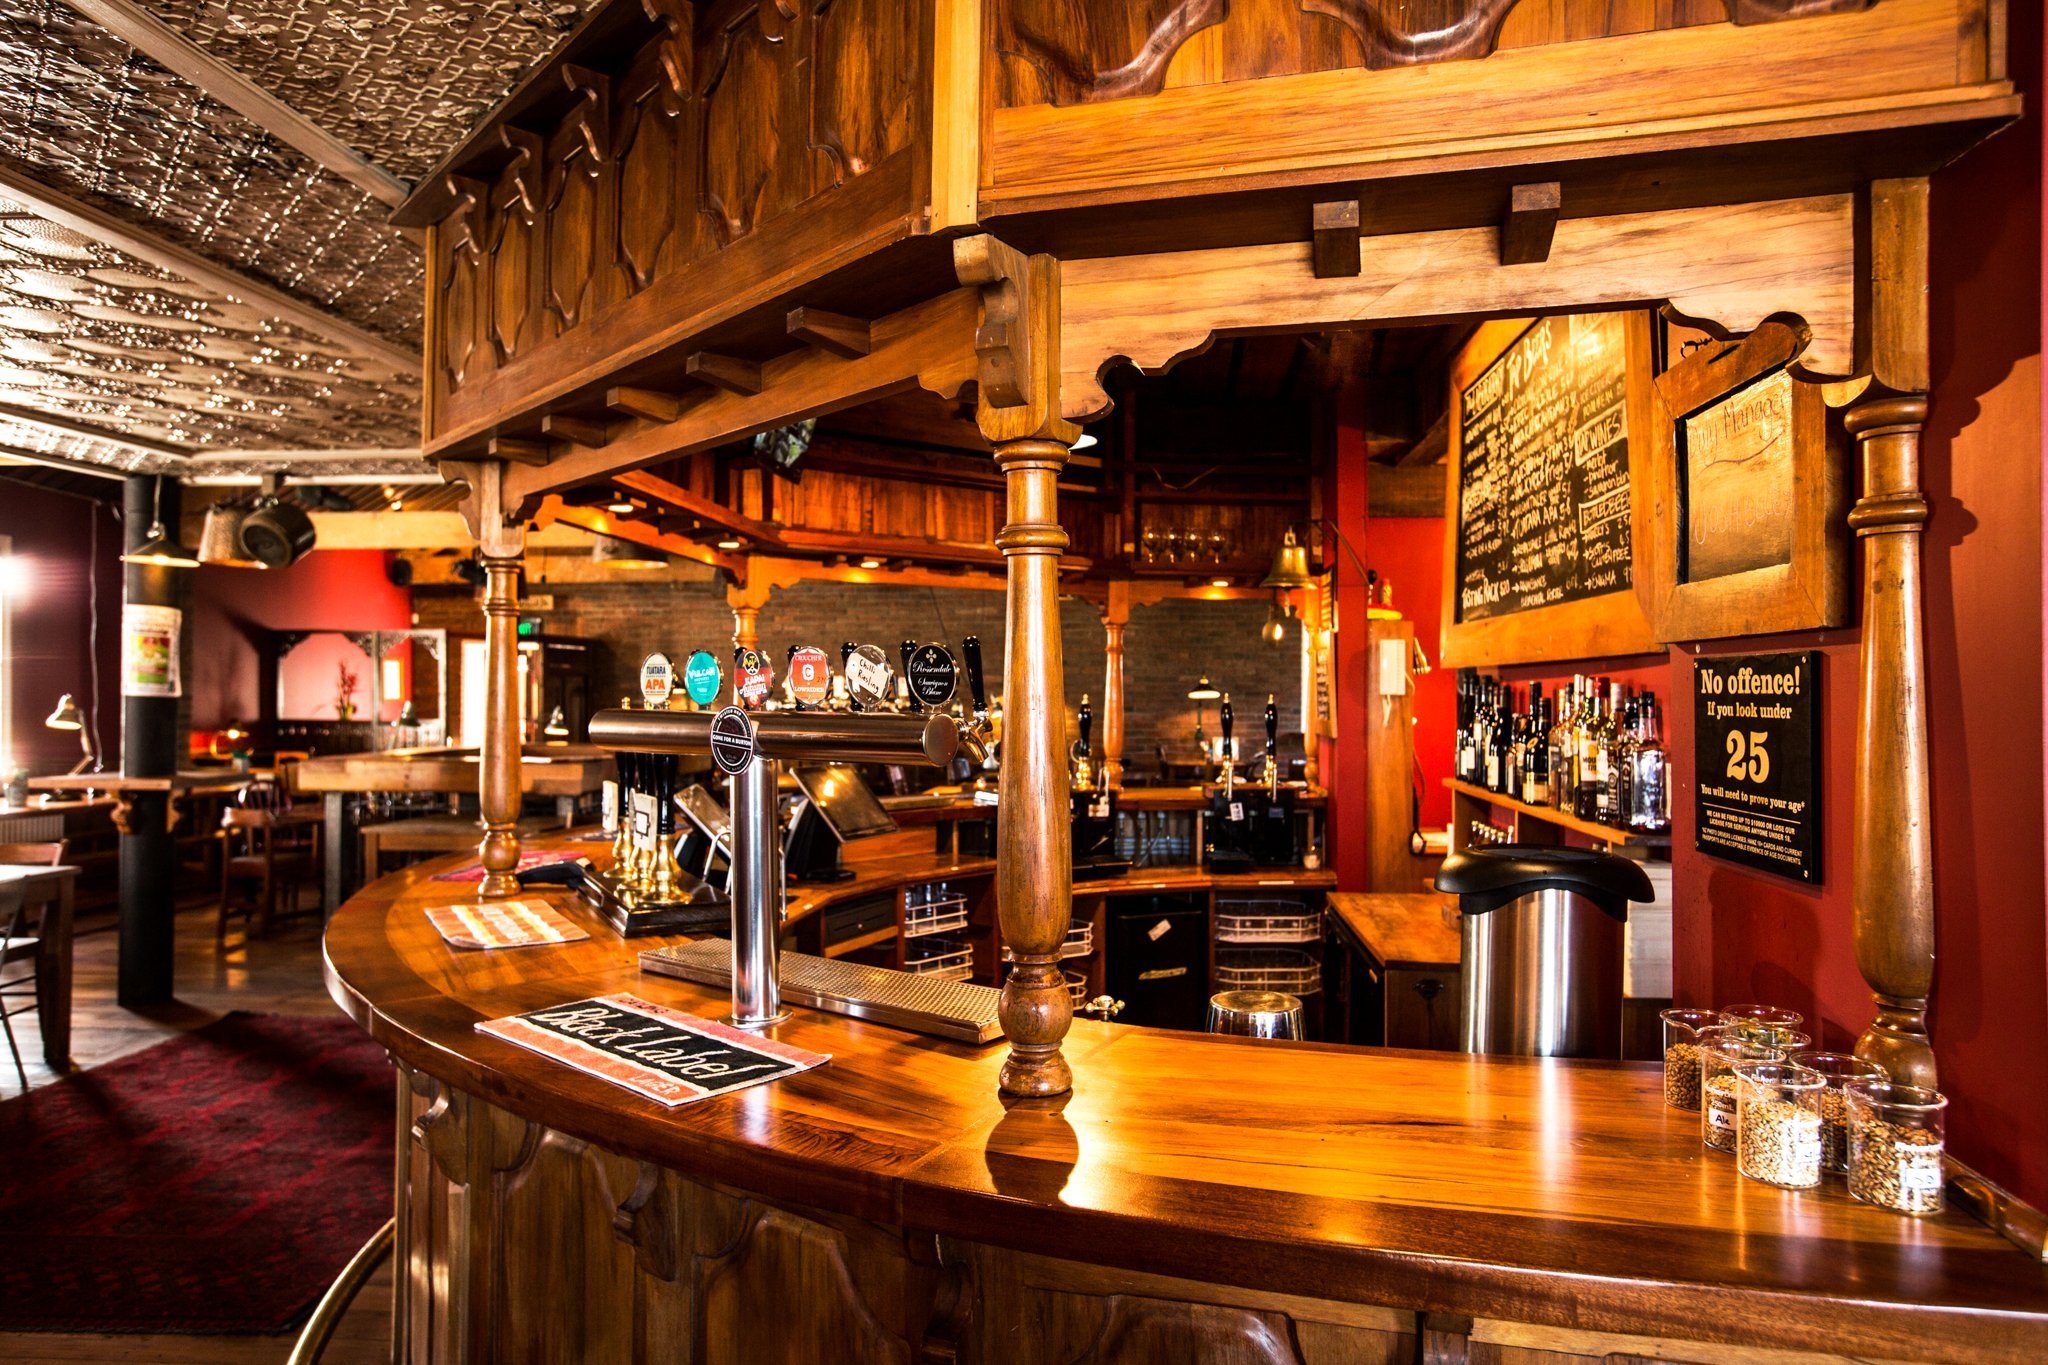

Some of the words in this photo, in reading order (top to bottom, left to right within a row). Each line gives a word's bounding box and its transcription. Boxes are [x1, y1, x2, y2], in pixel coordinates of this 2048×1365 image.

[1723, 388, 1786, 442] Manager
[1590, 412, 1621, 450] WINES
[1543, 506, 1558, 526] APA
[646, 666, 667, 674] TUATARA
[688, 666, 715, 679] VULCAN
[858, 658, 876, 675] Chilli
[912, 660, 952, 673] Rossendale
[645, 679, 666, 690] APA
[793, 685, 825, 694] LOWRIDER
[857, 670, 880, 695] Riesling
[917, 676, 949, 688] Sauvignon
[1701, 668, 1723, 694] No
[1727, 665, 1800, 695] offence!
[921, 686, 942, 696] Blanc
[1707, 701, 1716, 715] If
[1716, 705, 1734, 720] you
[1735, 702, 1758, 717] look
[1760, 702, 1792, 719] under
[713, 734, 724, 742] GONE
[724, 735, 732, 743] FOR
[735, 738, 751, 746] BURTON
[1726, 729, 1770, 783] 25
[1701, 783, 1712, 795] You
[1713, 786, 1724, 797] will
[1725, 790, 1740, 800] need
[1741, 790, 1748, 802] to
[1749, 794, 1769, 805] prove
[1769, 798, 1787, 809] your
[1706, 809, 1713, 817] WE
[1726, 814, 1738, 823] FINED
[1766, 822, 1773, 830] OR
[1773, 823, 1785, 832] LOSE
[1785, 826, 1795, 835] OUR
[1709, 818, 1725, 828] LICENSE
[1725, 820, 1733, 829] FOR
[1733, 823, 1751, 833] SERVING
[1751, 826, 1768, 837] ANYONE
[1768, 829, 1784, 841] UNDER
[1702, 834, 1719, 844] PASSPORTS
[1726, 839, 1747, 851] ACCEPTABLE
[1747, 843, 1764, 856] EVIDENCE
[1769, 849, 1778, 859] AGE
[1707, 828, 1718, 836] PHOTO
[1763, 841, 1776, 849] CARDS
[1776, 843, 1784, 852] AND
[1784, 846, 1803, 857] CURRENT
[528, 1007, 642, 1045] Black
[615, 1026, 777, 1079] Label
[627, 1070, 681, 1096] LAGER
[1715, 1114, 1731, 1126] Ale
